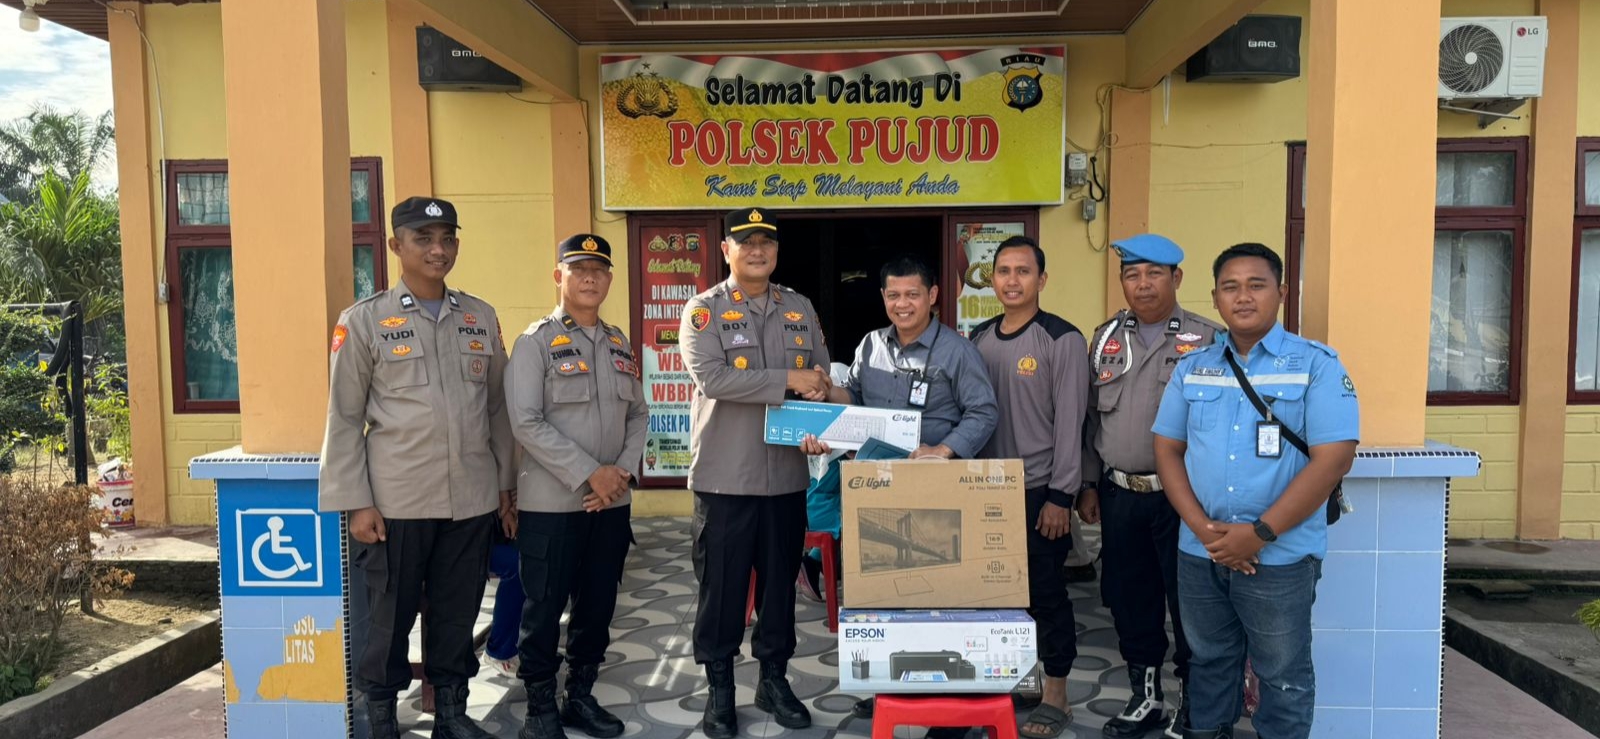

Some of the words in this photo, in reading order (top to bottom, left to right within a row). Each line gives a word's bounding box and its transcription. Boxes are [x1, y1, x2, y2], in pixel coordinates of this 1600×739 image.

[705, 74, 816, 105] Selamat
[827, 72, 924, 108] Datang
[934, 73, 961, 102] Di
[667, 118, 840, 167] POLSEK
[848, 116, 1000, 165] PUJUD
[705, 173, 757, 197] Kami
[762, 173, 808, 199] Siap
[813, 173, 903, 199] Melayani
[904, 172, 960, 196] Anda
[652, 285, 659, 300] DI
[661, 285, 697, 300] KAWASAN
[644, 304, 662, 319] ZONA
[959, 295, 980, 319] 16
[980, 305, 1004, 318] KAP
[458, 327, 487, 336] POLRI
[722, 322, 748, 331] BOY
[784, 324, 808, 332] POLRI
[381, 329, 414, 341] YUDI
[661, 330, 679, 340] MENU
[657, 353, 688, 371] WB
[1101, 356, 1124, 365] EZA
[679, 414, 690, 433] PU
[845, 628, 885, 638] EPSON
[285, 639, 315, 664] LITAS
